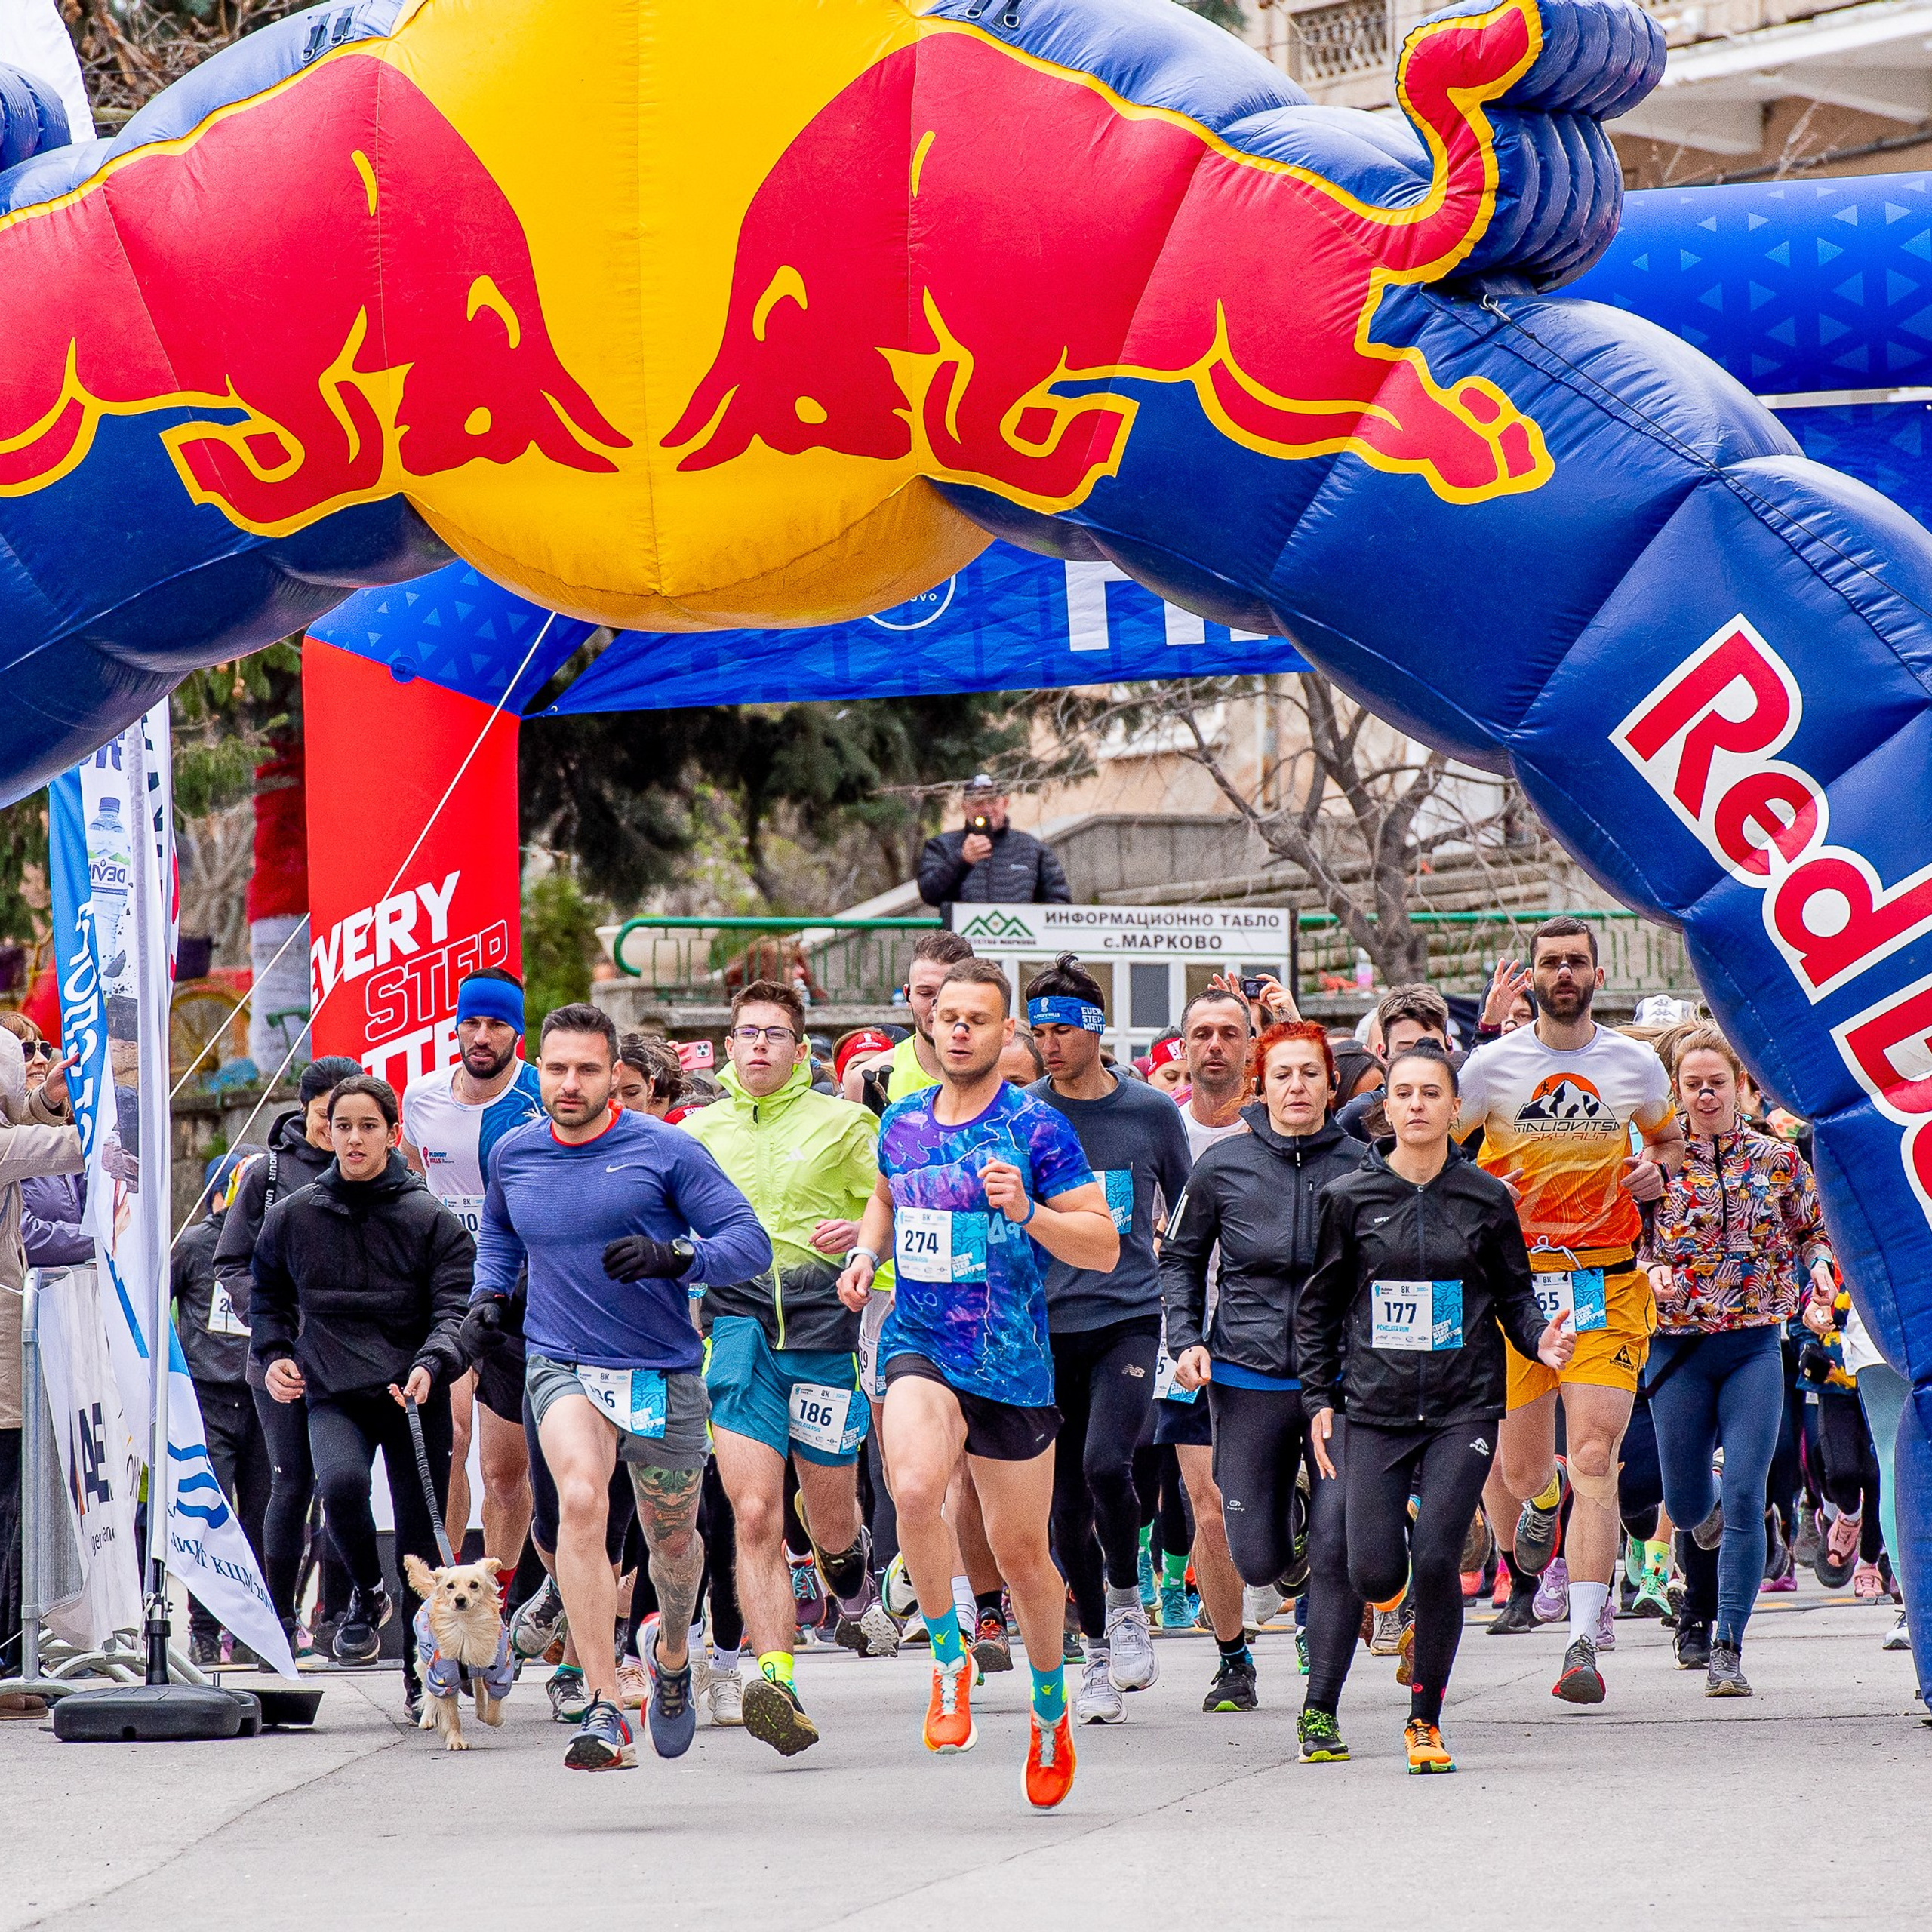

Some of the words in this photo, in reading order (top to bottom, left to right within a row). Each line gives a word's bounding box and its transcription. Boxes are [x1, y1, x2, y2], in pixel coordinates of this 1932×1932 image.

[1608, 612, 1932, 1006] Red
[1044, 911, 1214, 928] ИНФОРМАЦИОННО
[1220, 913, 1280, 928] ТАБЛО
[1103, 934, 1223, 949] с.МАРКОВО
[365, 919, 509, 1041] STEP
[1082, 1015, 1103, 1023] STEP
[905, 1230, 939, 1254] 274
[1384, 1301, 1417, 1324] 177
[799, 1399, 833, 1426] 186
